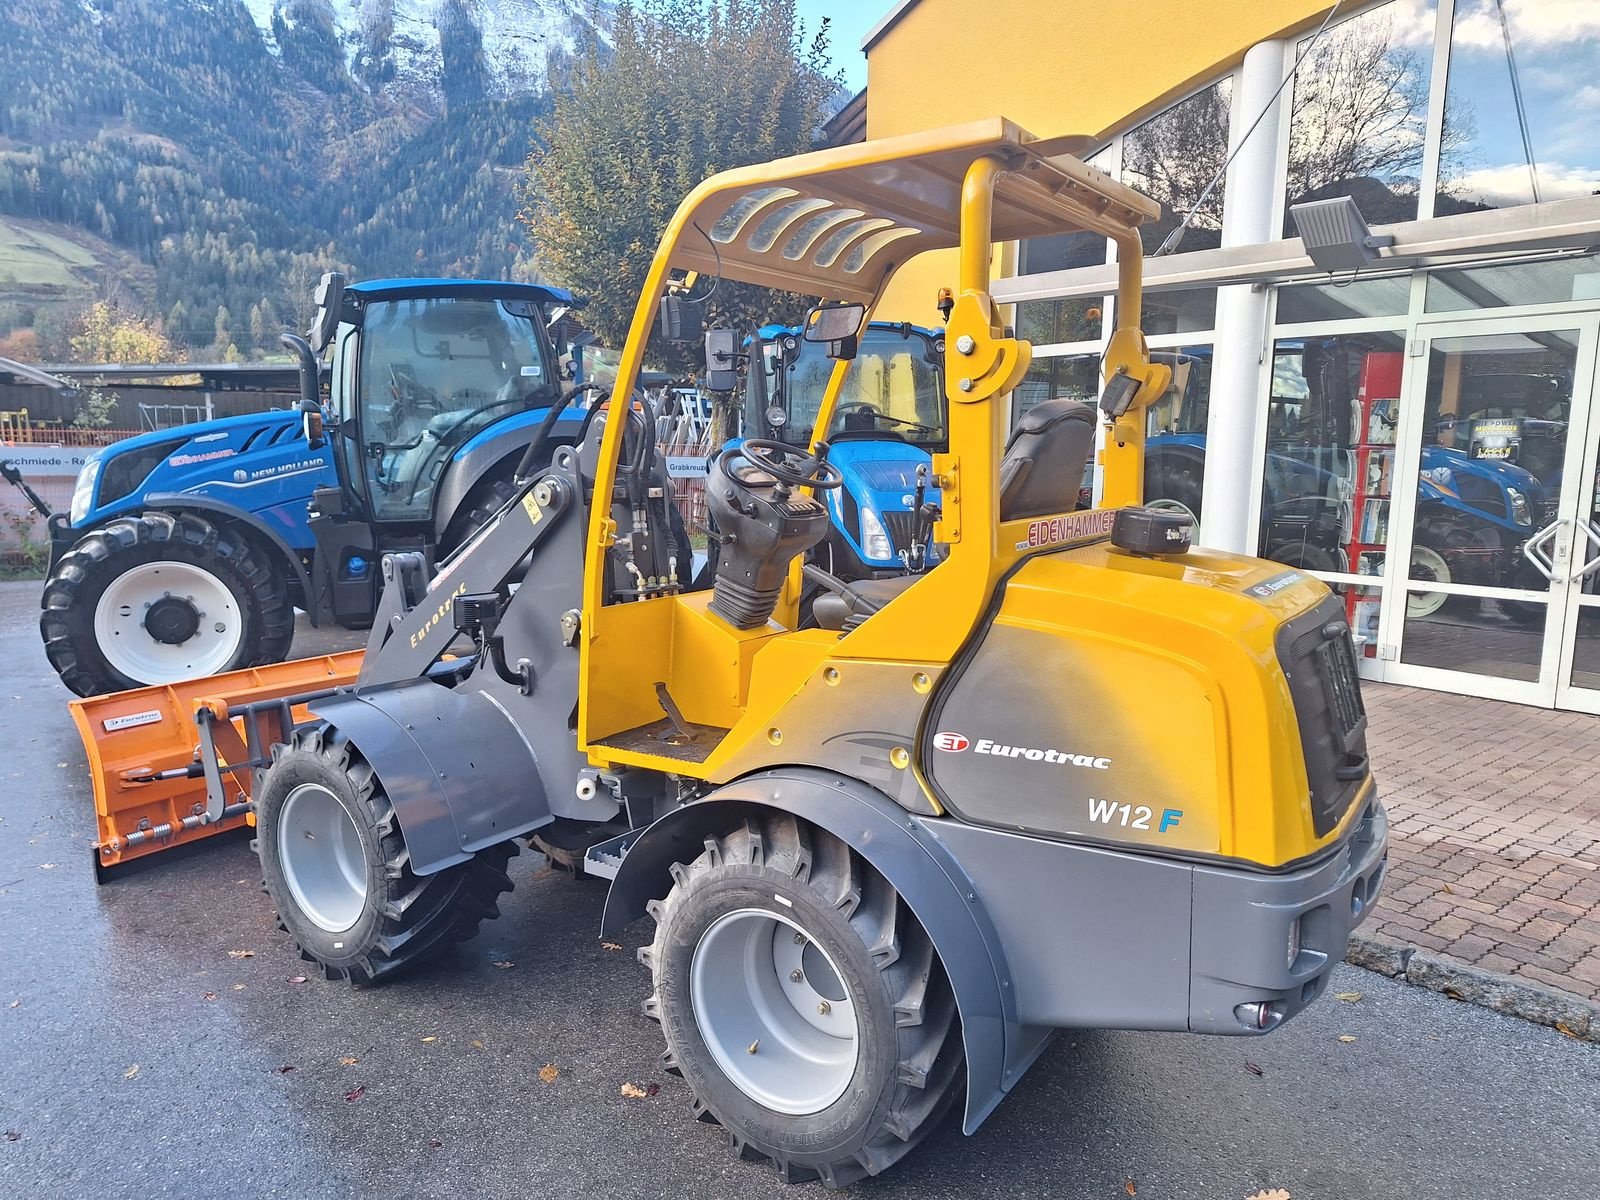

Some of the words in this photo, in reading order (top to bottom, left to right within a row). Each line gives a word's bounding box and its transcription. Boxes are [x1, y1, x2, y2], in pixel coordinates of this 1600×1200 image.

[251, 468, 276, 479] NEW
[278, 458, 324, 474] HOLLAND
[974, 738, 1112, 769] Eurotrac
[1088, 798, 1152, 830] W12
[1158, 808, 1183, 832] F
